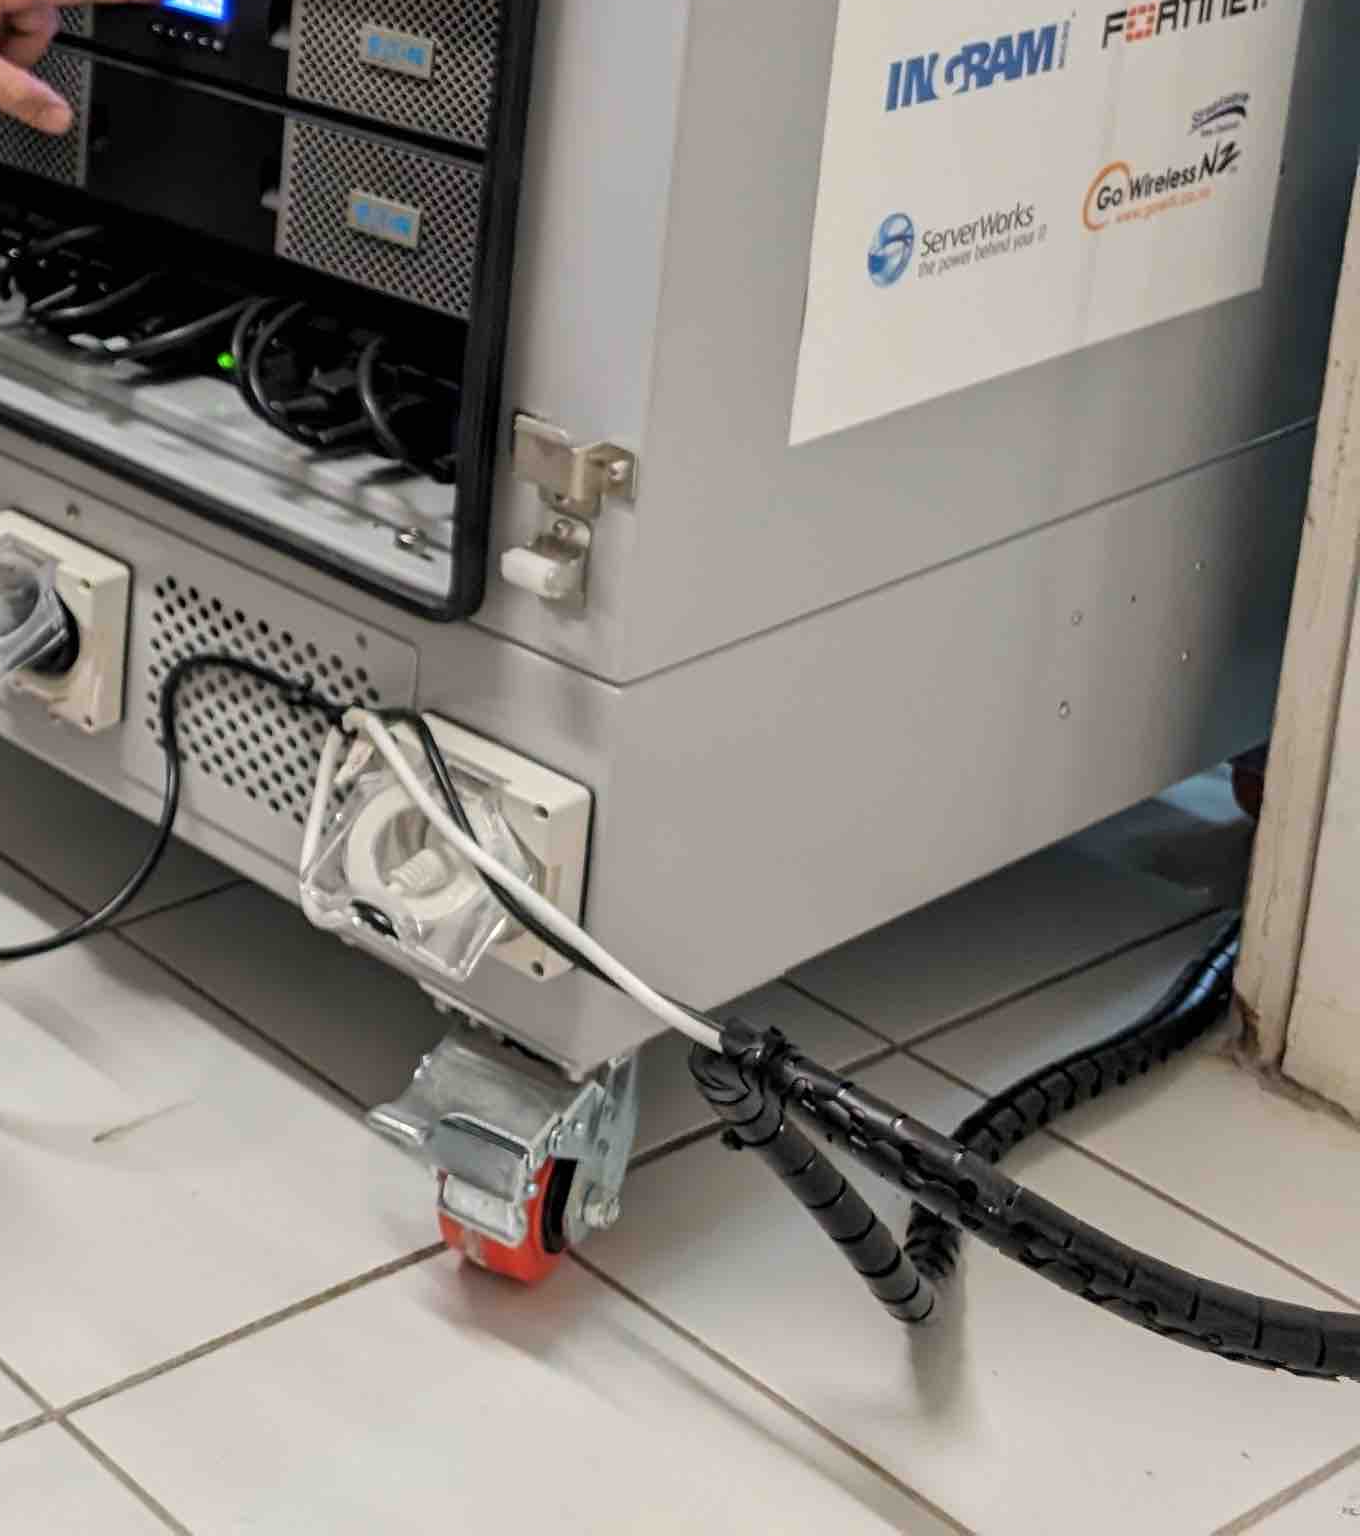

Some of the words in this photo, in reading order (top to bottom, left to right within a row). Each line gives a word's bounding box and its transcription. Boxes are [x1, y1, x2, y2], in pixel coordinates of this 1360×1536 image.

[885, 24, 1058, 112] INGRAM
[1096, 185, 1123, 211] Go
[1129, 165, 1197, 201] Wireless
[1199, 138, 1241, 182] NZ
